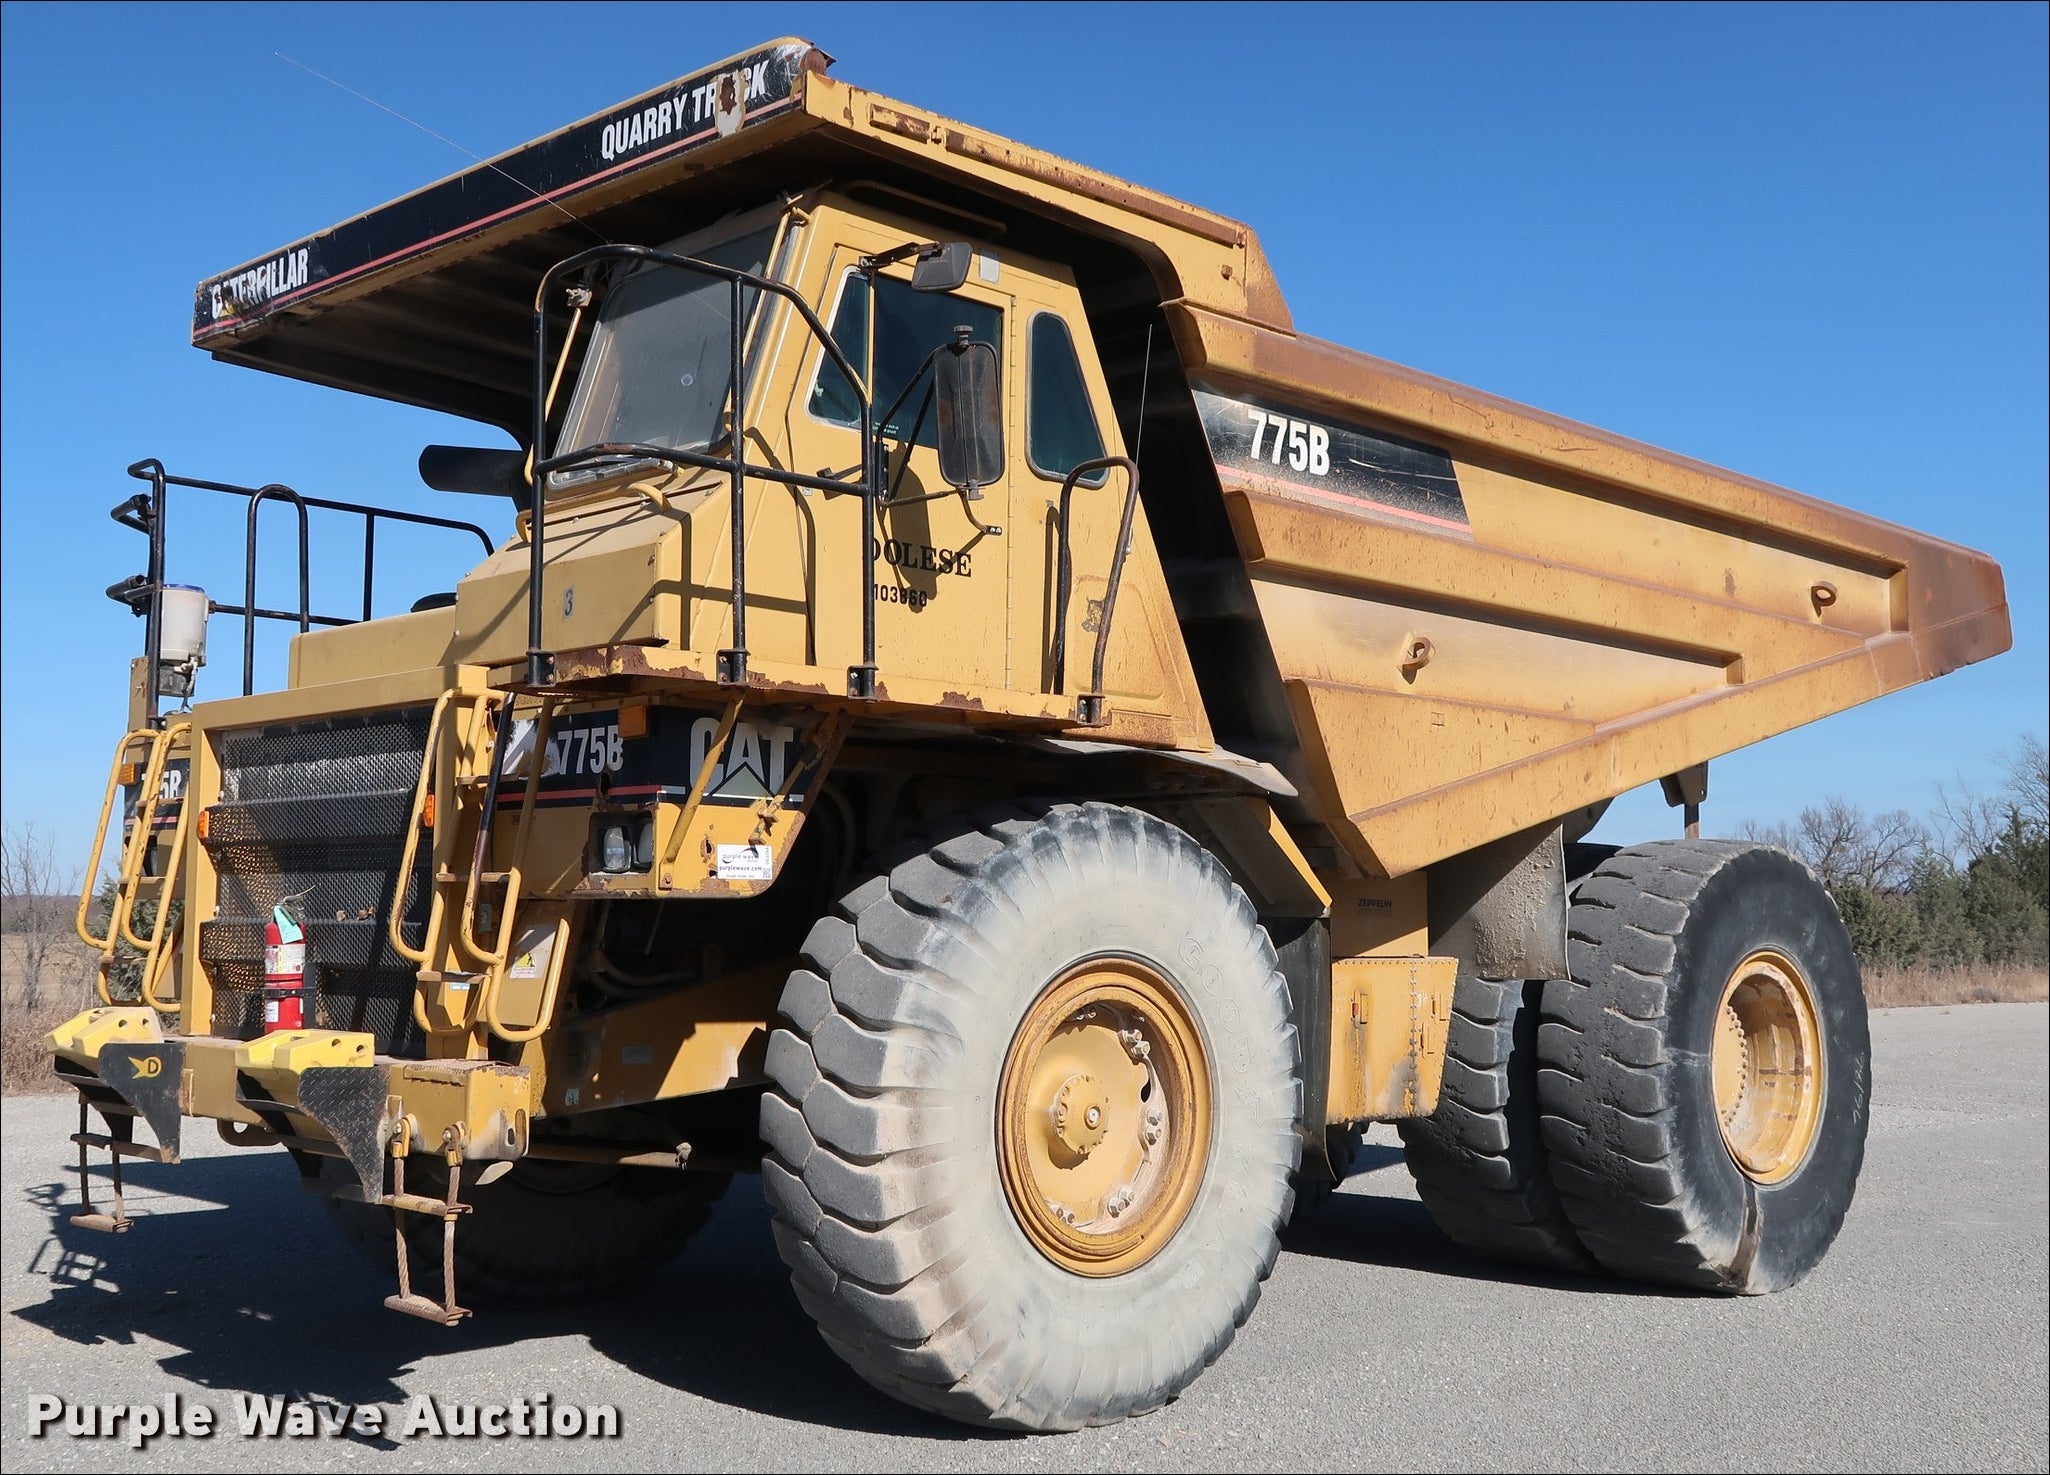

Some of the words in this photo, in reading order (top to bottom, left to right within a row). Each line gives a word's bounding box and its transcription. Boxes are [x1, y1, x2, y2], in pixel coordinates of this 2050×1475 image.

[601, 93, 688, 162] QUARRY
[692, 59, 769, 124] TRCK
[211, 247, 309, 320] CTERPILLAR
[1248, 408, 1331, 476] 775B
[564, 587, 575, 618] 3
[557, 724, 624, 776] 775B
[690, 716, 794, 797] CAT
[1357, 898, 1392, 909] ZEPPELIN
